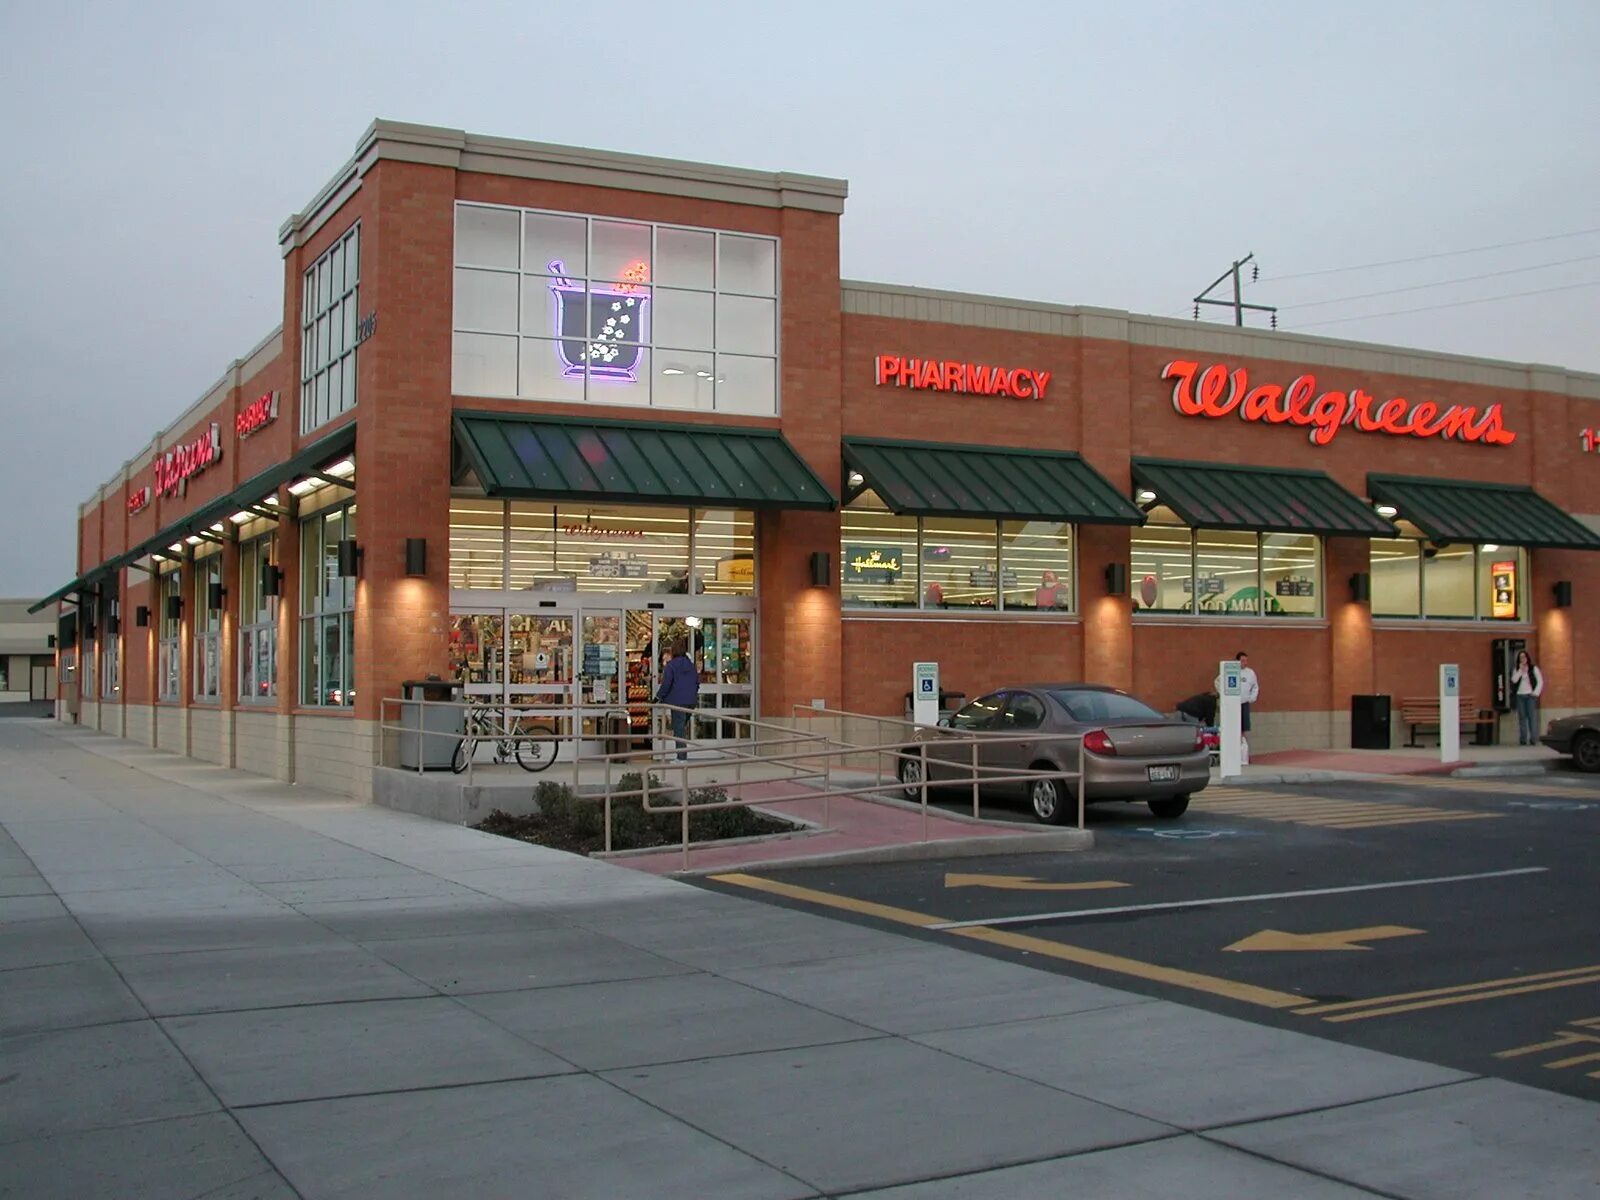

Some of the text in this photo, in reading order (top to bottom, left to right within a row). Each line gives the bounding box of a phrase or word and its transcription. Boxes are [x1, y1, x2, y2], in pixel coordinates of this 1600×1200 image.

[874, 355, 1052, 400] PHARMACY
[236, 391, 280, 438] PHARMACY
[1161, 360, 1517, 445] Walgreens
[850, 556, 900, 573] Hallmark
